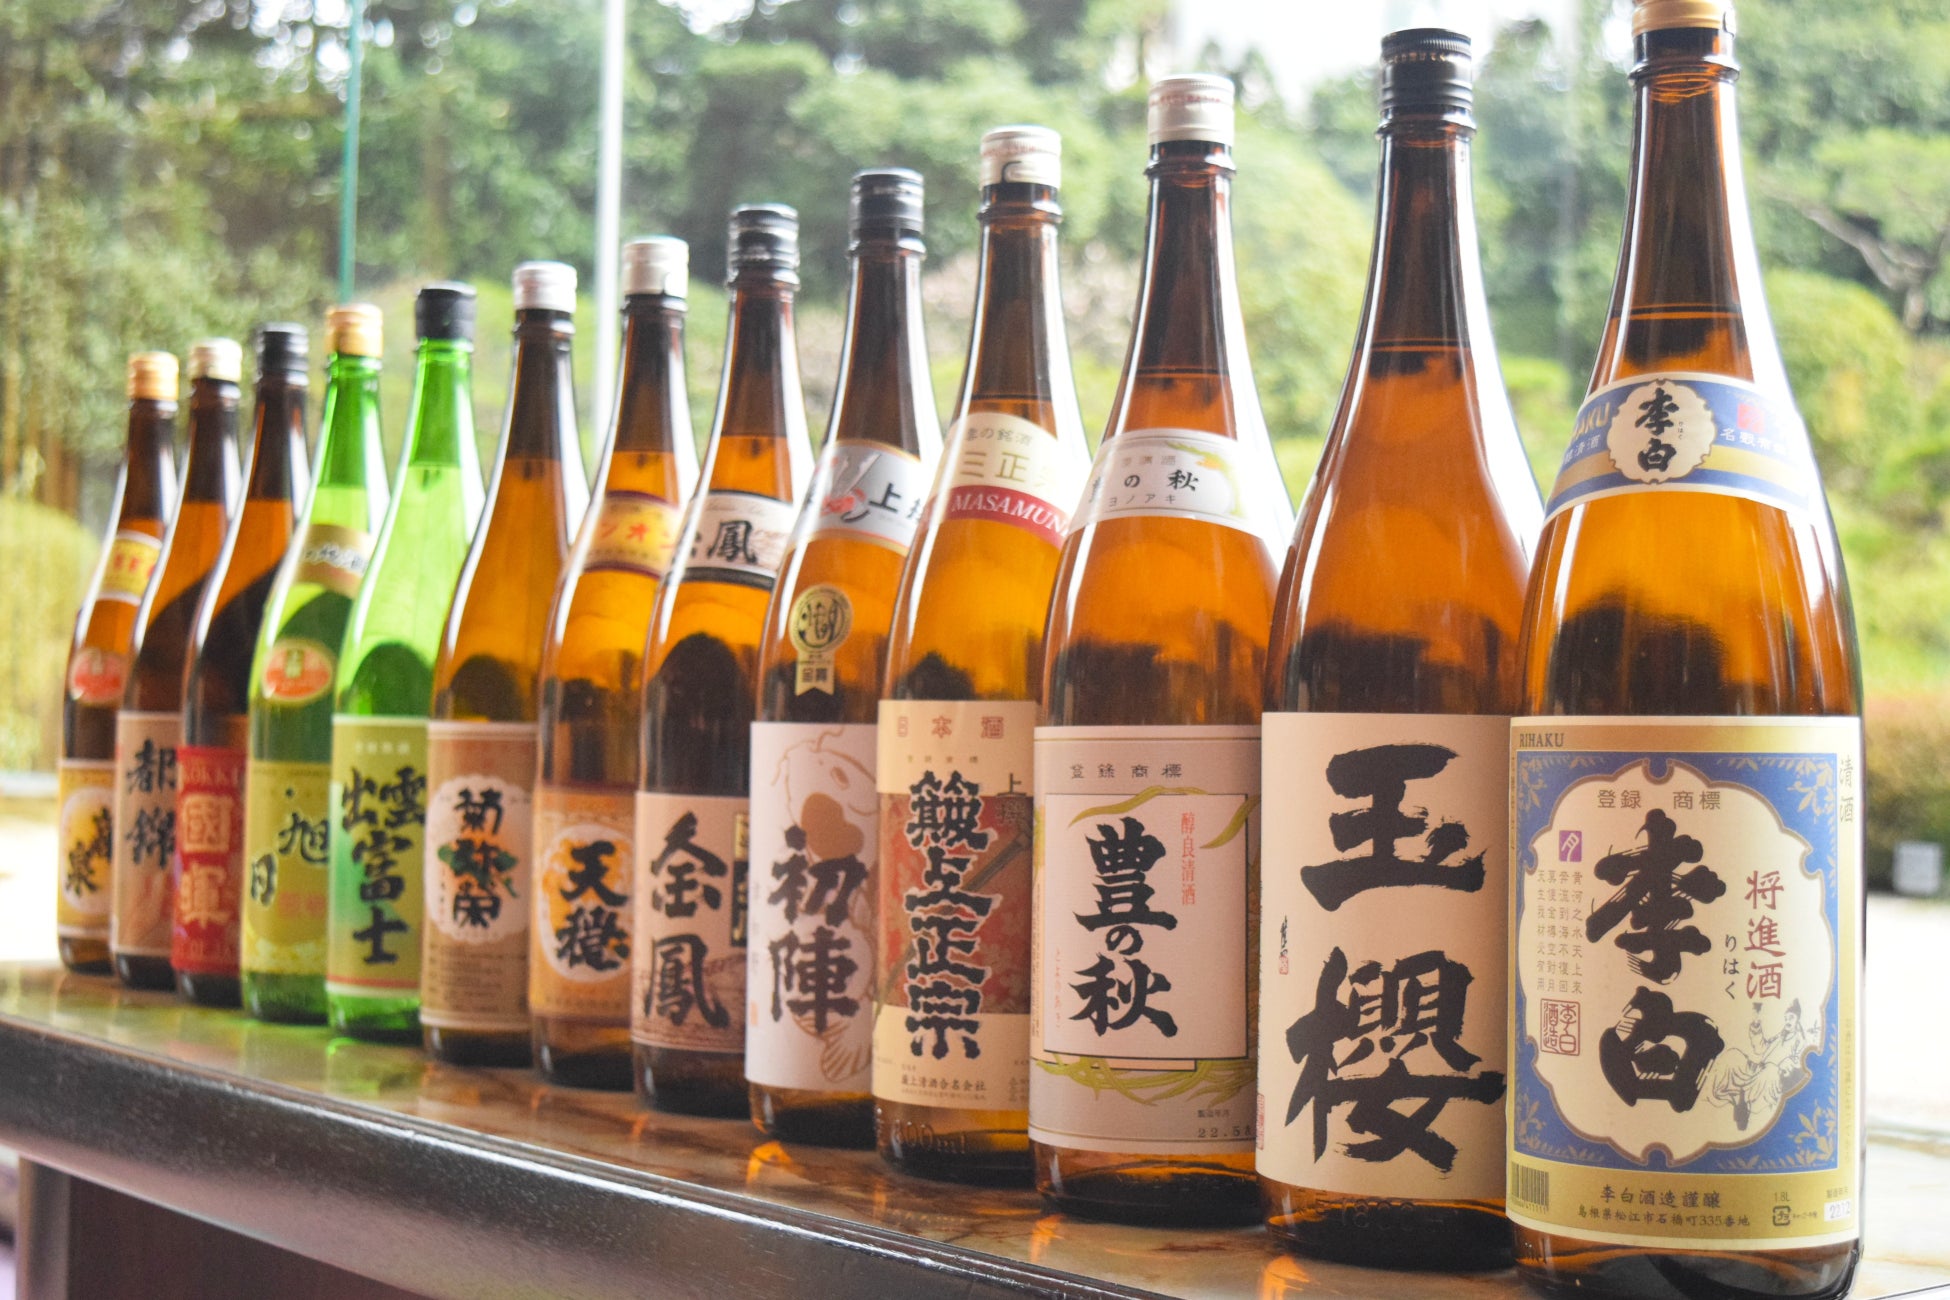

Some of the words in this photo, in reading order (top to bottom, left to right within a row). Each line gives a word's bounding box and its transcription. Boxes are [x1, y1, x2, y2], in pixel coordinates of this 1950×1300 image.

[1634, 387, 1679, 473] 李白
[1519, 732, 1565, 748] RIHAKU
[1585, 808, 1727, 1114] 李白
[1723, 934, 1741, 1000] りはく
